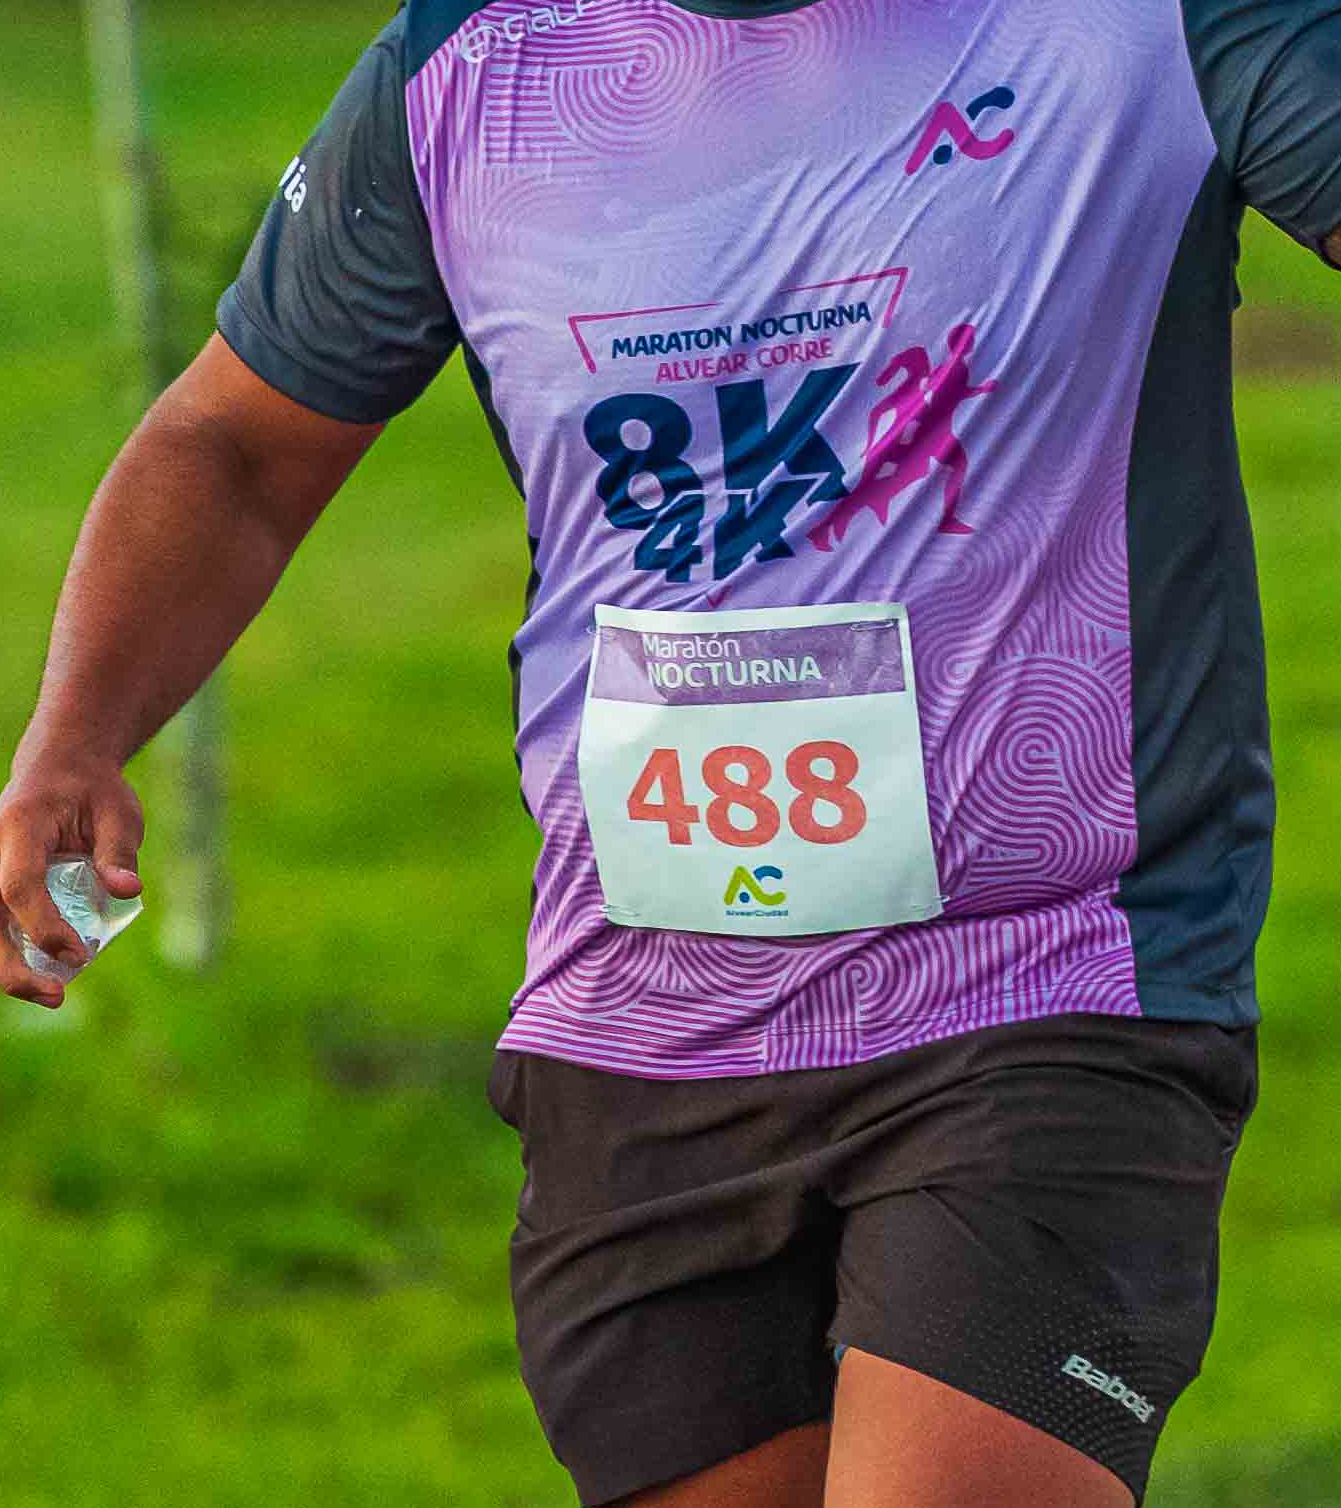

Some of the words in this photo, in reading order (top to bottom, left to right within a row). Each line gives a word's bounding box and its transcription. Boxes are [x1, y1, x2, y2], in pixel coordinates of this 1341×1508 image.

[611, 326, 733, 360] MARATON
[740, 300, 872, 343] NOCTURNA
[656, 351, 749, 385] ALVEAR
[755, 337, 834, 371] CORRE
[583, 362, 861, 531] 8K
[634, 473, 825, 584] 4K
[642, 632, 741, 659] Maratón
[646, 655, 822, 689] NOCTURNA
[626, 740, 868, 848] 488
